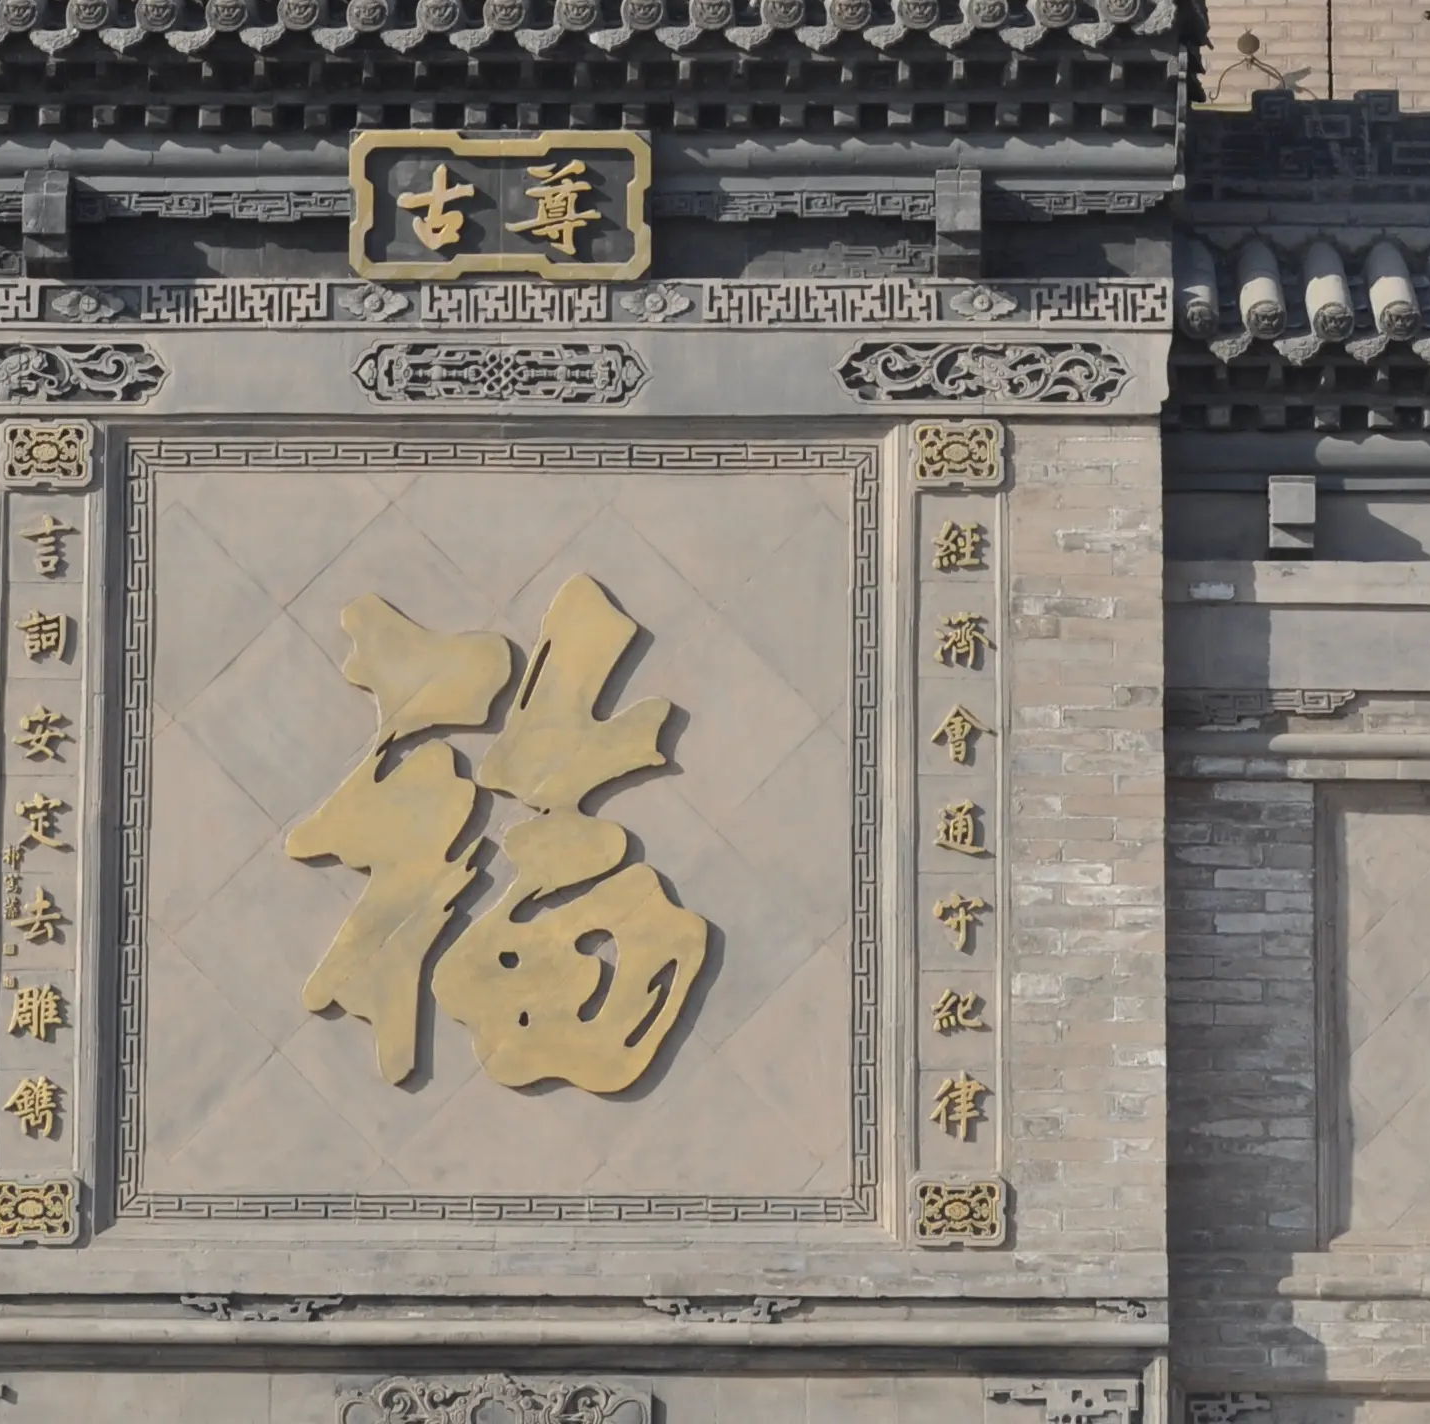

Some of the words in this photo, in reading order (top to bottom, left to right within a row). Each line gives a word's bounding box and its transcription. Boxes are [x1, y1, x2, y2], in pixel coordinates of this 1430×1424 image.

[285, 573, 708, 1093] 福
[930, 520, 996, 1142] 經濟會通守紀律
